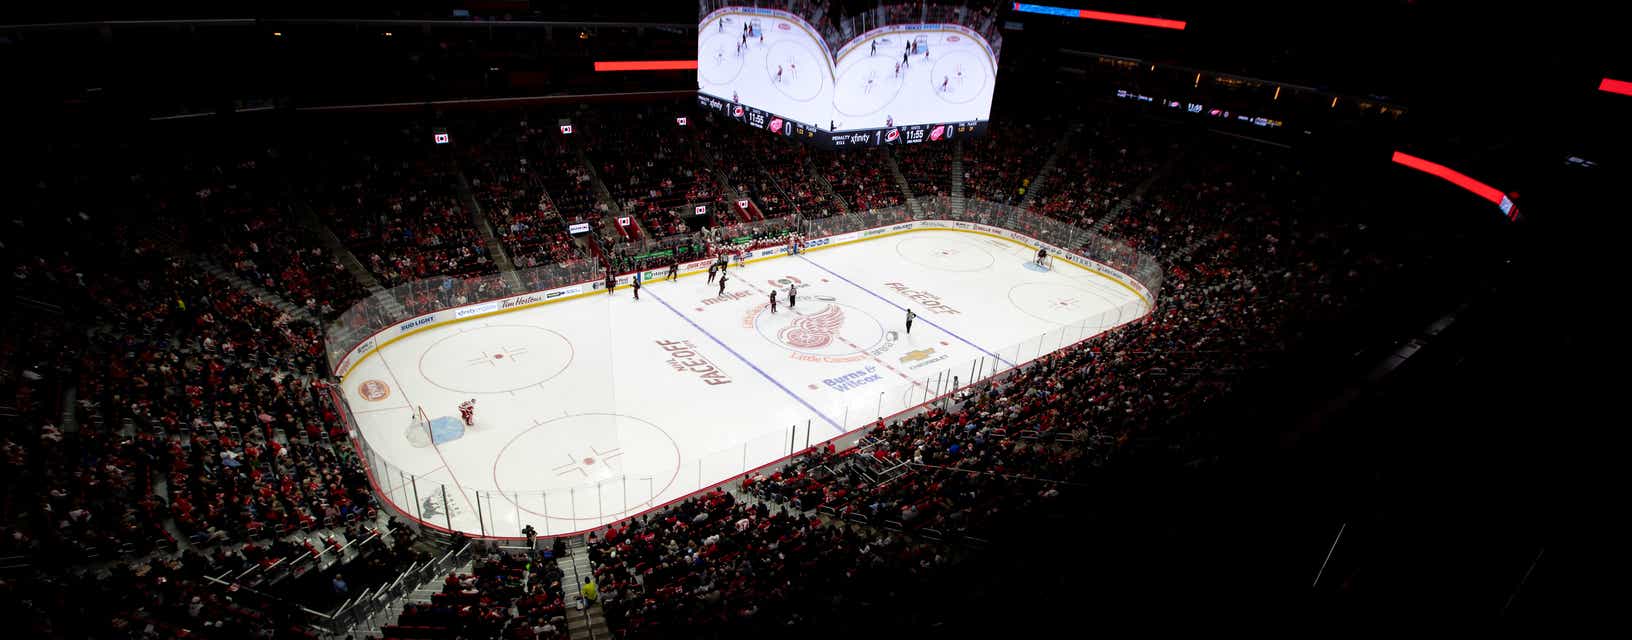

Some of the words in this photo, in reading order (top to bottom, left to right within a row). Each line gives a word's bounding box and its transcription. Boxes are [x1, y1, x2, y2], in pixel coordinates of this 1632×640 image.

[850, 132, 870, 144] xfinity
[906, 129, 924, 140] 11:55
[946, 125, 954, 138] 0
[515, 295, 542, 305] Hortons
[401, 321, 416, 332] BUD
[415, 316, 434, 327] LIGHT
[821, 369, 867, 388] Burns
[832, 374, 884, 392] Wilcox
